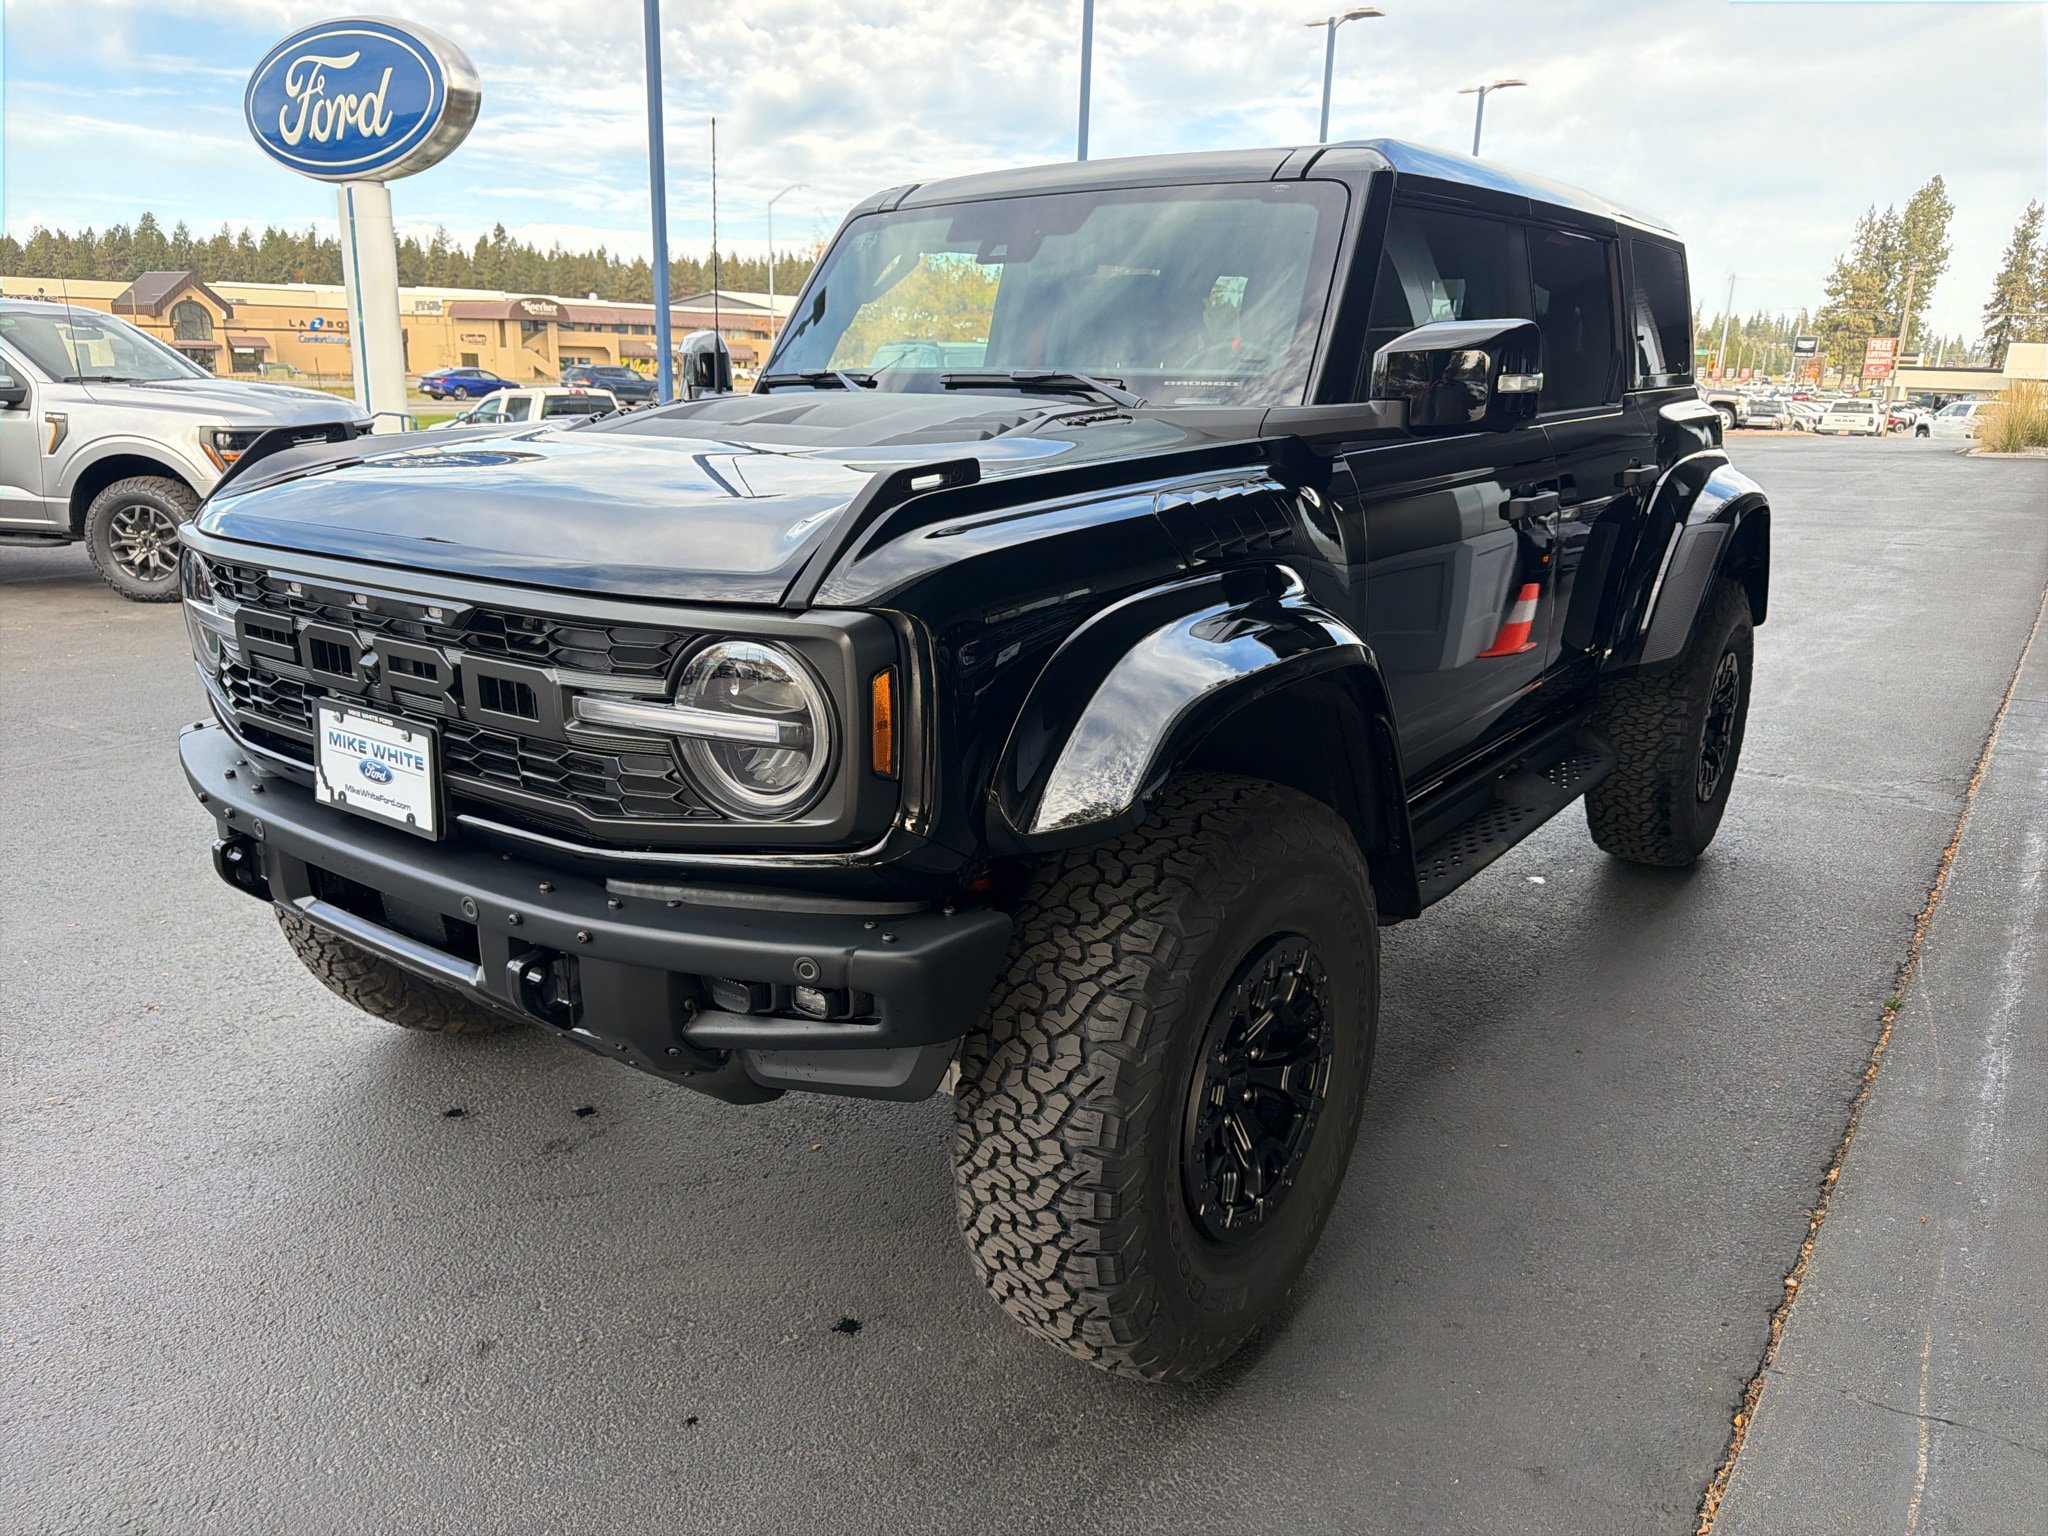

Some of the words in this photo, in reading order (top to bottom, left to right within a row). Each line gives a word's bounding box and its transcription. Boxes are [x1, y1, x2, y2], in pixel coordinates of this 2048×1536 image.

[279, 51, 393, 146] Ford
[1870, 340, 1893, 351] FREE
[235, 605, 574, 742] FORD
[347, 709, 361, 718] MIKE
[361, 712, 379, 723] WHITE
[328, 731, 368, 755] MIKE
[371, 742, 425, 772] WHITE
[364, 761, 388, 782] Ford
[344, 783, 412, 812] MikeWhiteFord.com
